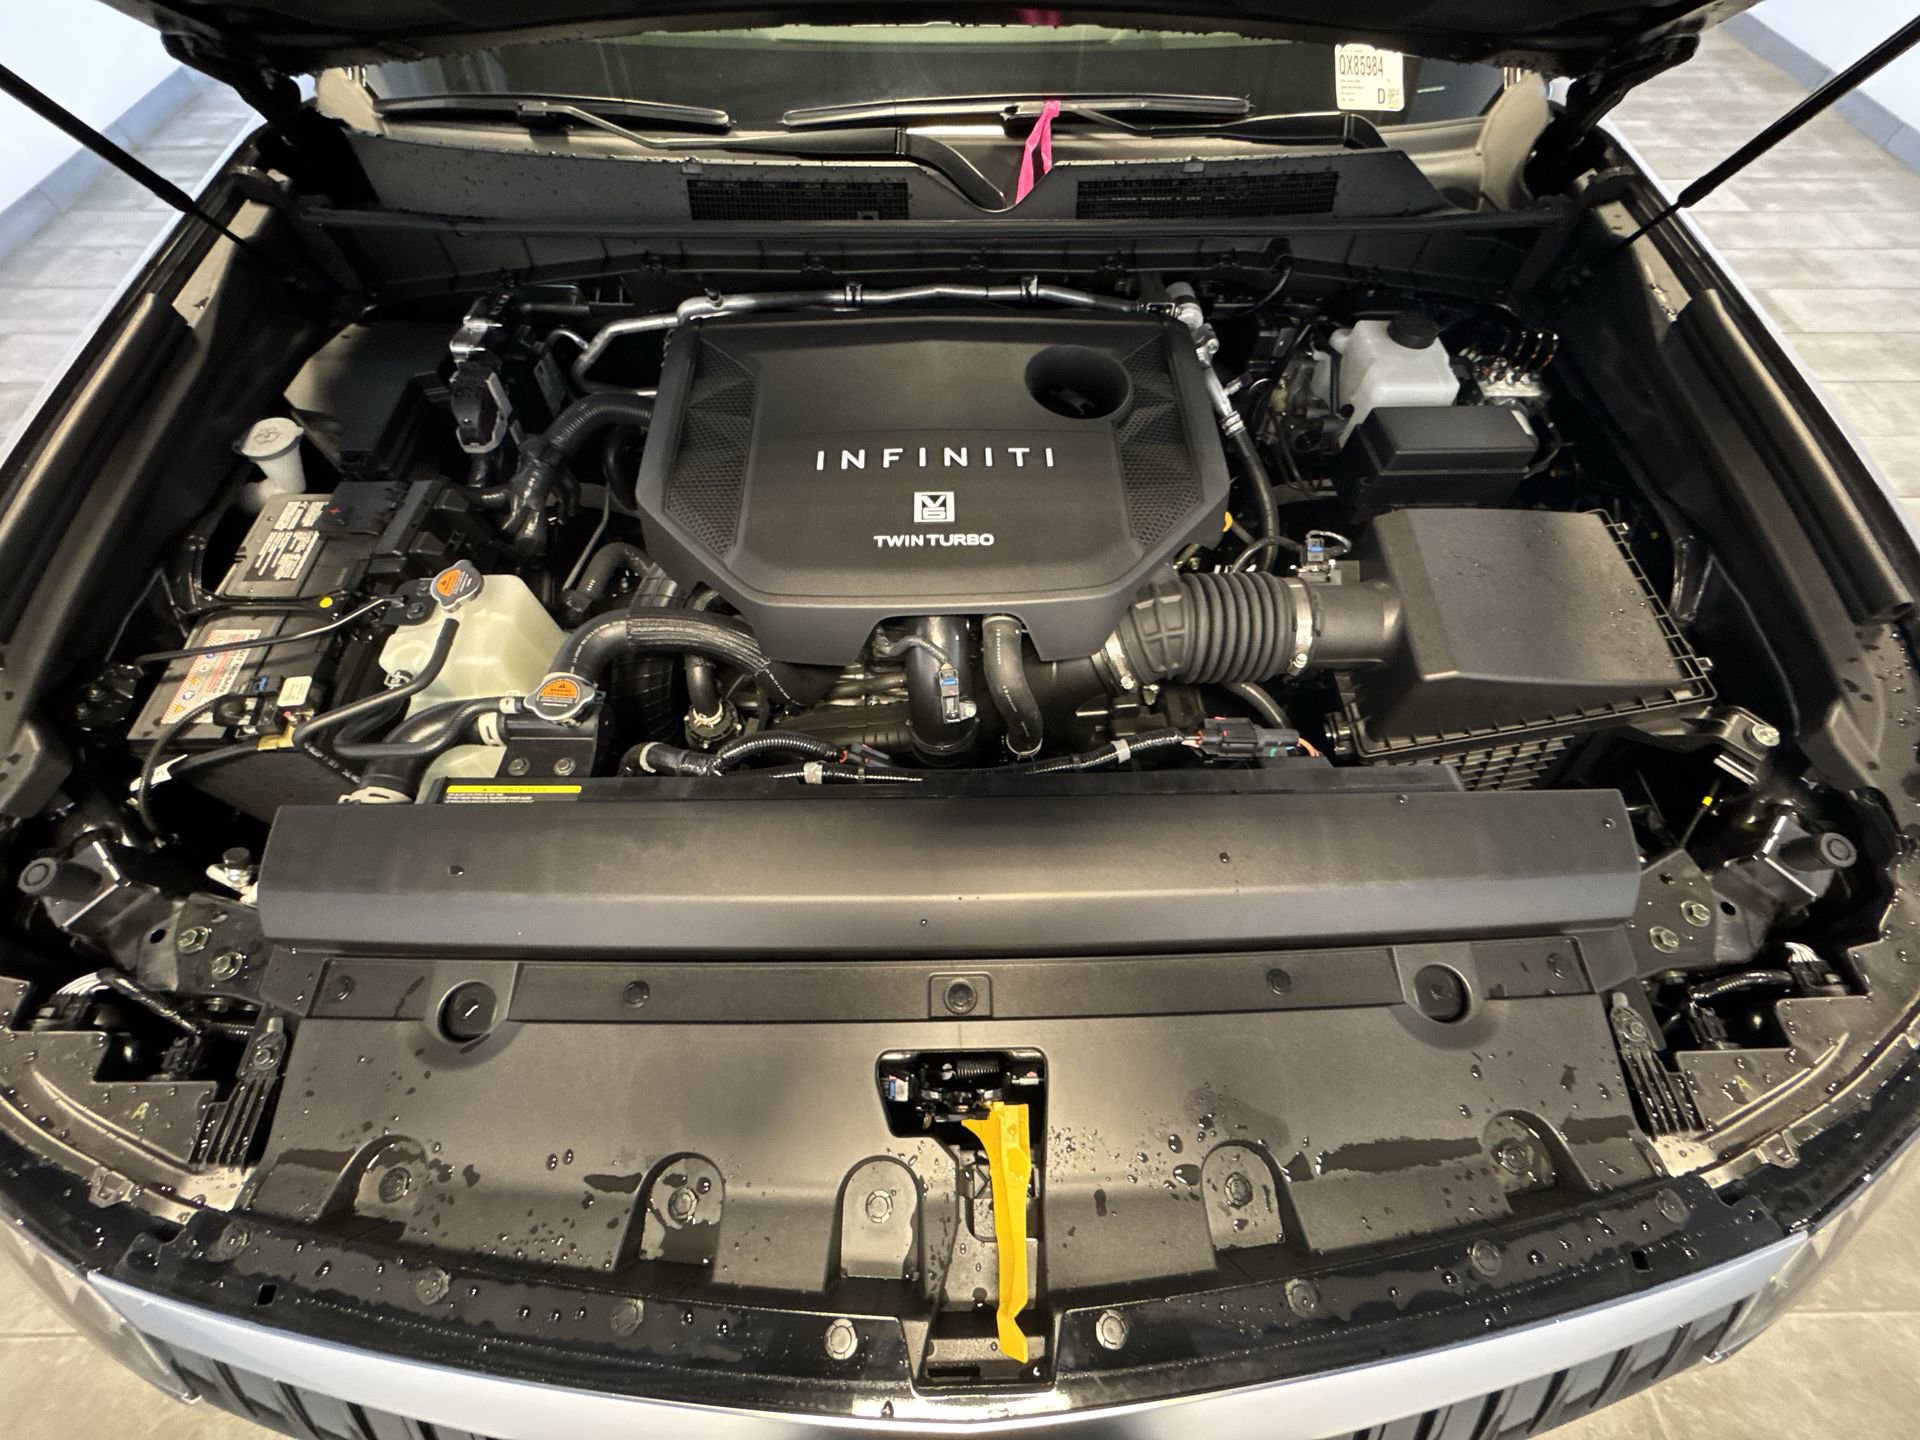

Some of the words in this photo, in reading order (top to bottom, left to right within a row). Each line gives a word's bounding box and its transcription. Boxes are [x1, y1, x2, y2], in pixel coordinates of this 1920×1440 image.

[1339, 54, 1384, 76] QX85984
[1377, 87, 1386, 105] D
[816, 446, 1054, 471] INFINITI
[873, 534, 924, 548] TWIN
[926, 532, 995, 547] TURBO
